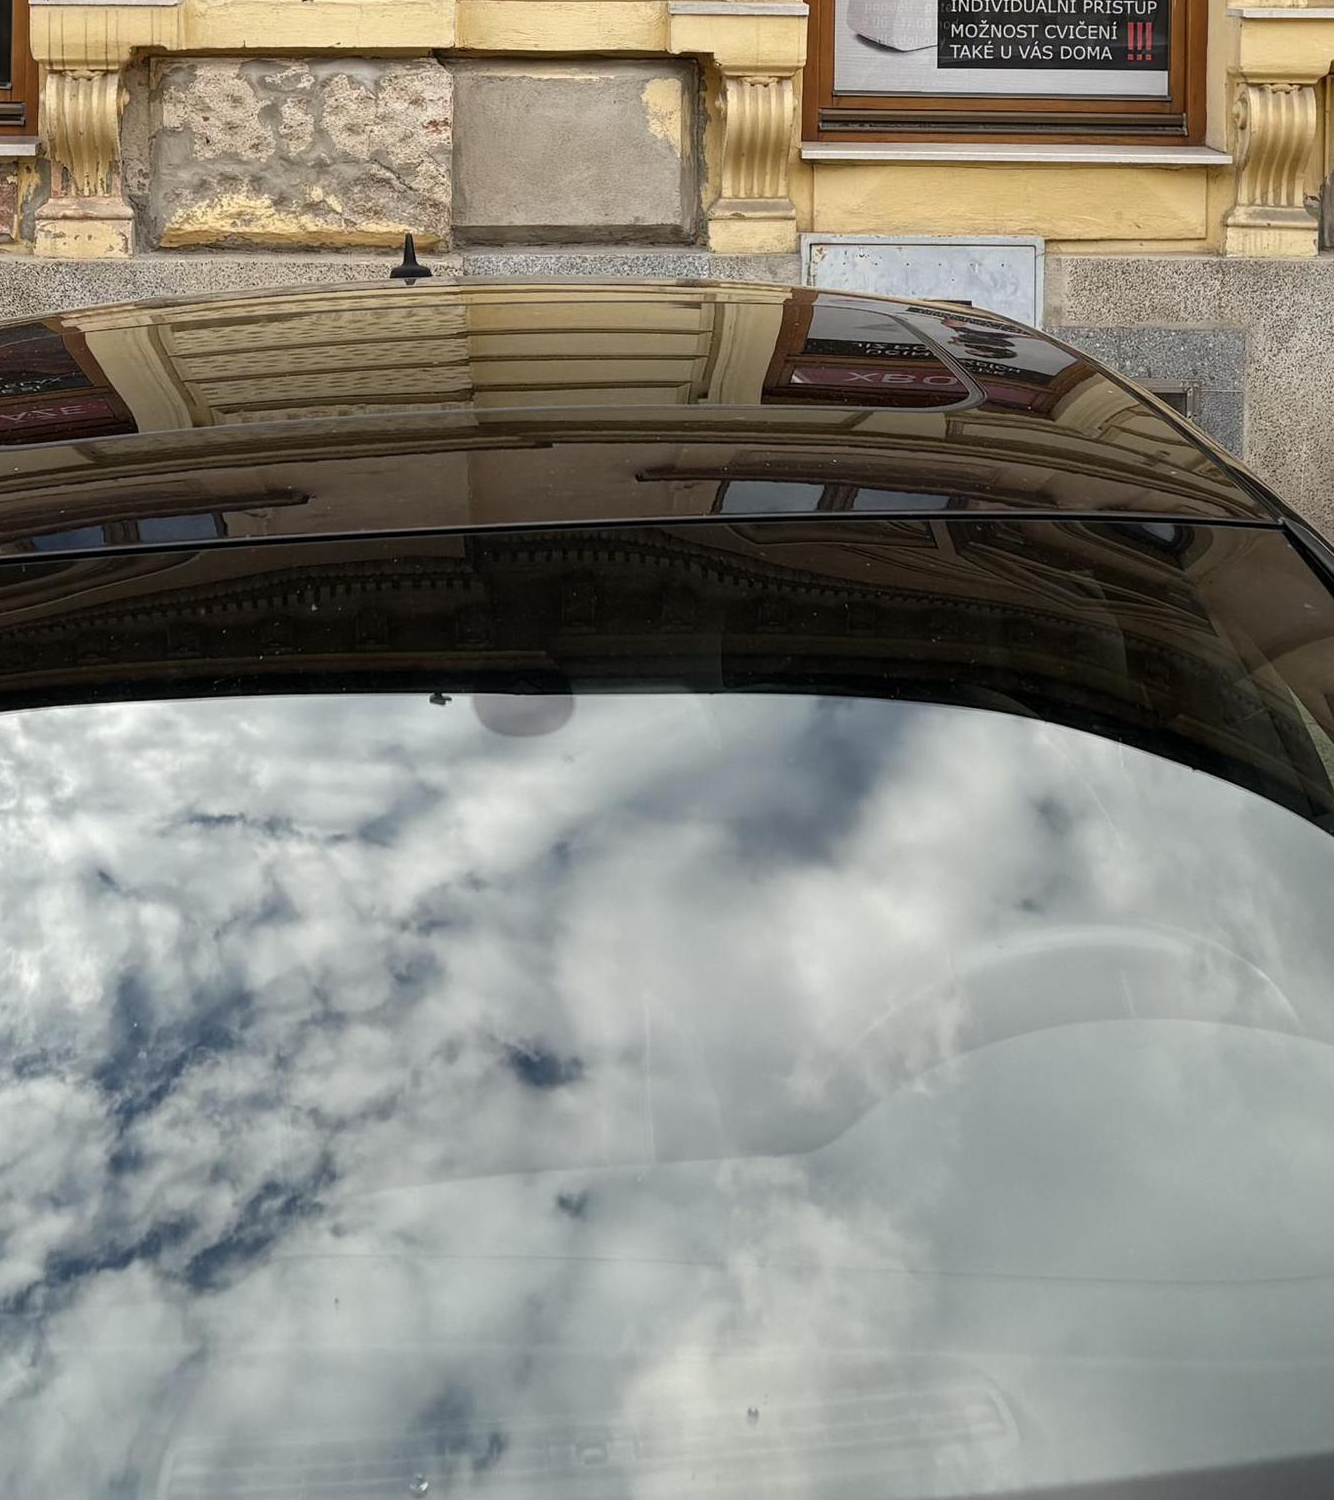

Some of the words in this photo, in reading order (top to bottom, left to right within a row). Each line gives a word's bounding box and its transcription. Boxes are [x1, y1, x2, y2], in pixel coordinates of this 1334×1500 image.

[950, 20, 1039, 39] MOŽNOST
[1044, 21, 1118, 40] CVIČENÍ
[1127, 21, 1153, 61] !!!
[950, 40, 995, 60] TAKÉ
[1001, 45, 1012, 60] U
[1018, 41, 1054, 60] VÁS
[1060, 45, 1113, 61] DOMA
